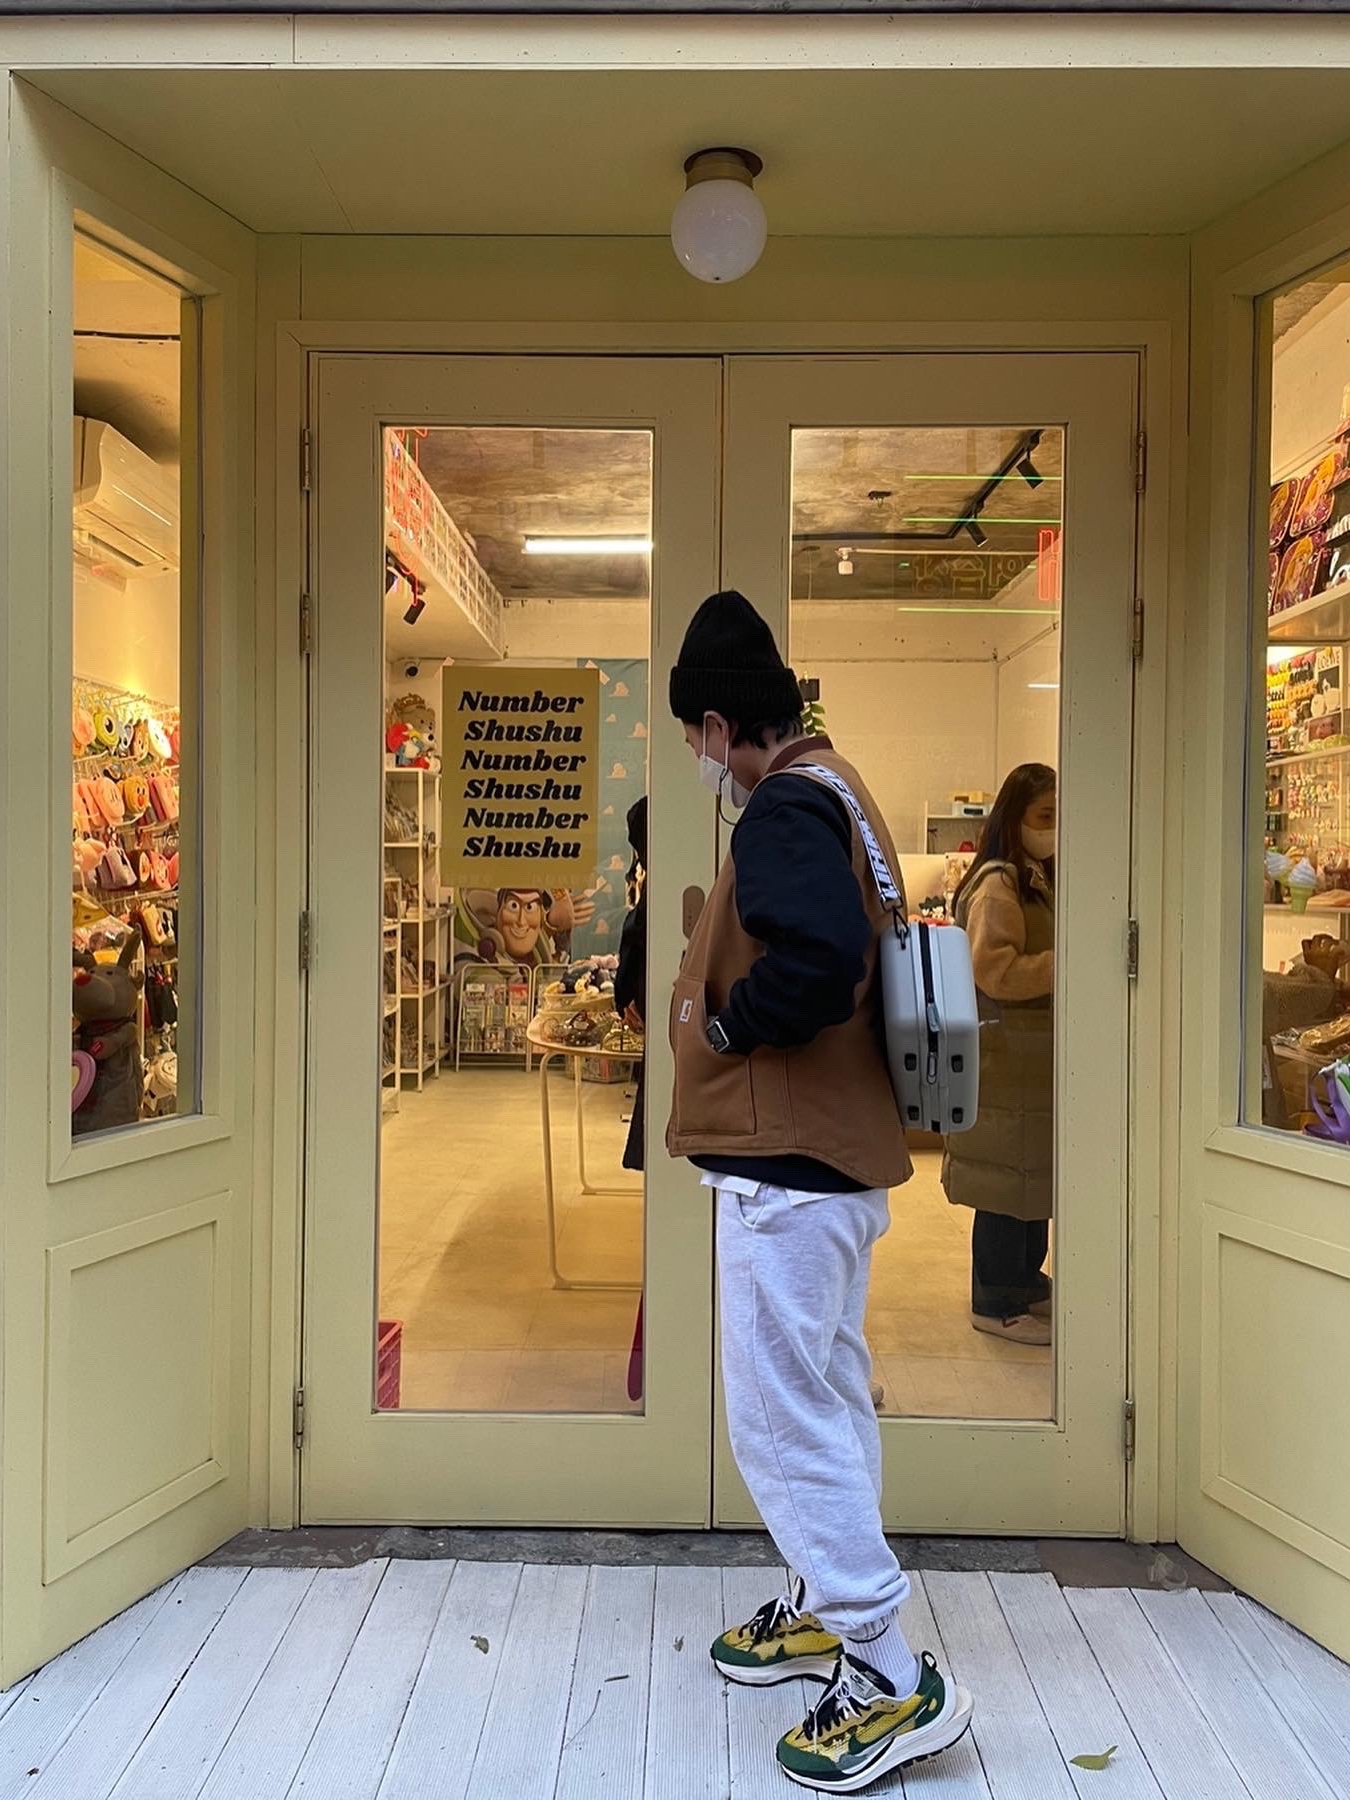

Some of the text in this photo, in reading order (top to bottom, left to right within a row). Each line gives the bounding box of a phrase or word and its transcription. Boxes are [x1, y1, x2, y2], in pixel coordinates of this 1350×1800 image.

[457, 690, 585, 714] Number
[463, 718, 583, 743] Shushu
[459, 748, 587, 772] Number
[463, 777, 582, 801] Shushu
[462, 806, 589, 830] Number
[462, 834, 582, 859] Shushu
